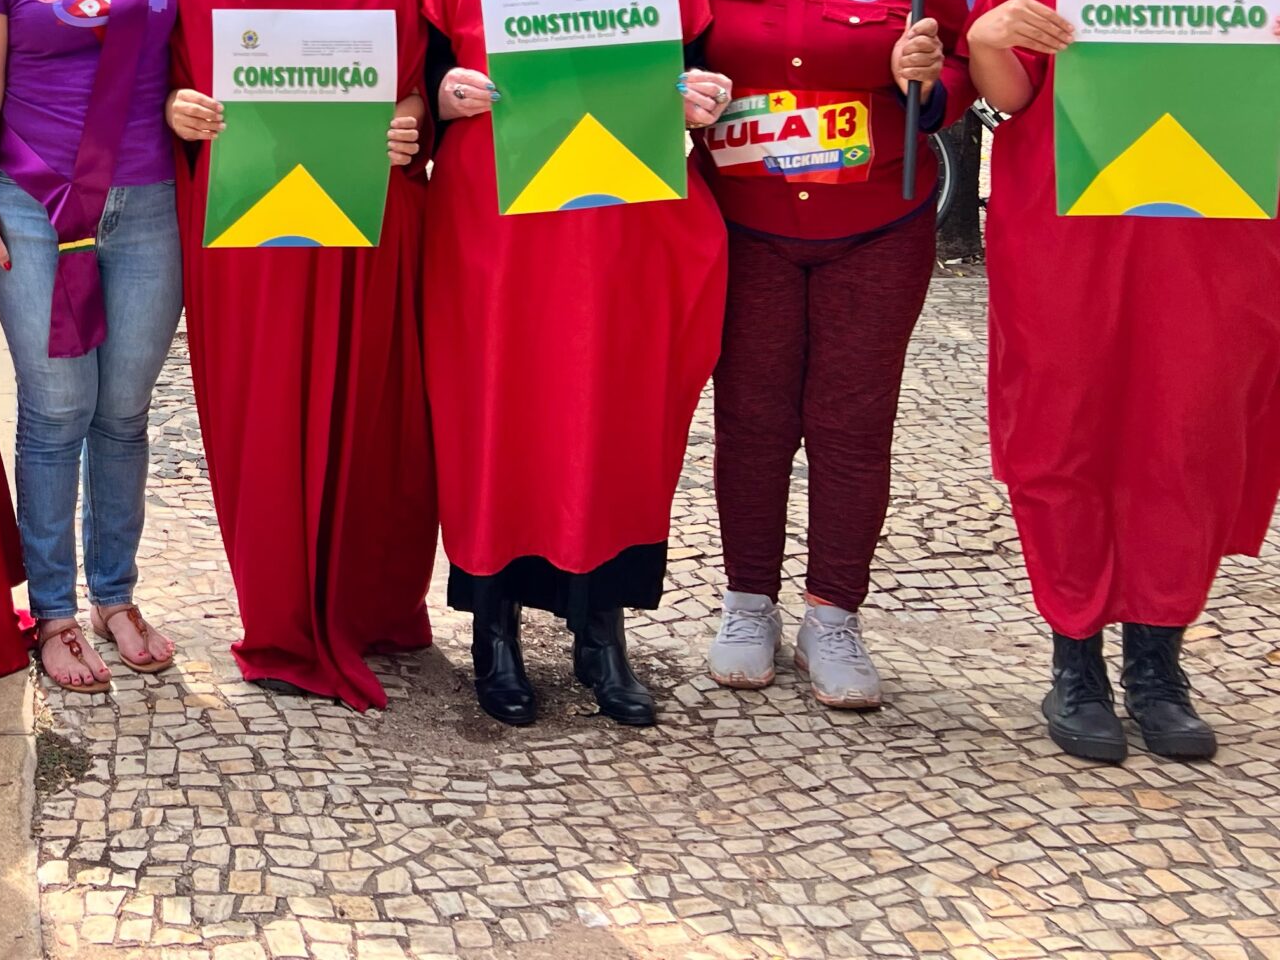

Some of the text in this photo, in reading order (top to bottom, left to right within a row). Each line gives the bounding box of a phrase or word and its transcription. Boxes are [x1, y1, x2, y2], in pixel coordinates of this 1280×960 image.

[505, 2, 659, 37] CONSTITUIÇÃO
[1081, 0, 1267, 34] CONSTITUIÇÃO
[233, 62, 378, 93] CONSTITUIÇÃO
[707, 106, 857, 151] LULA 13
